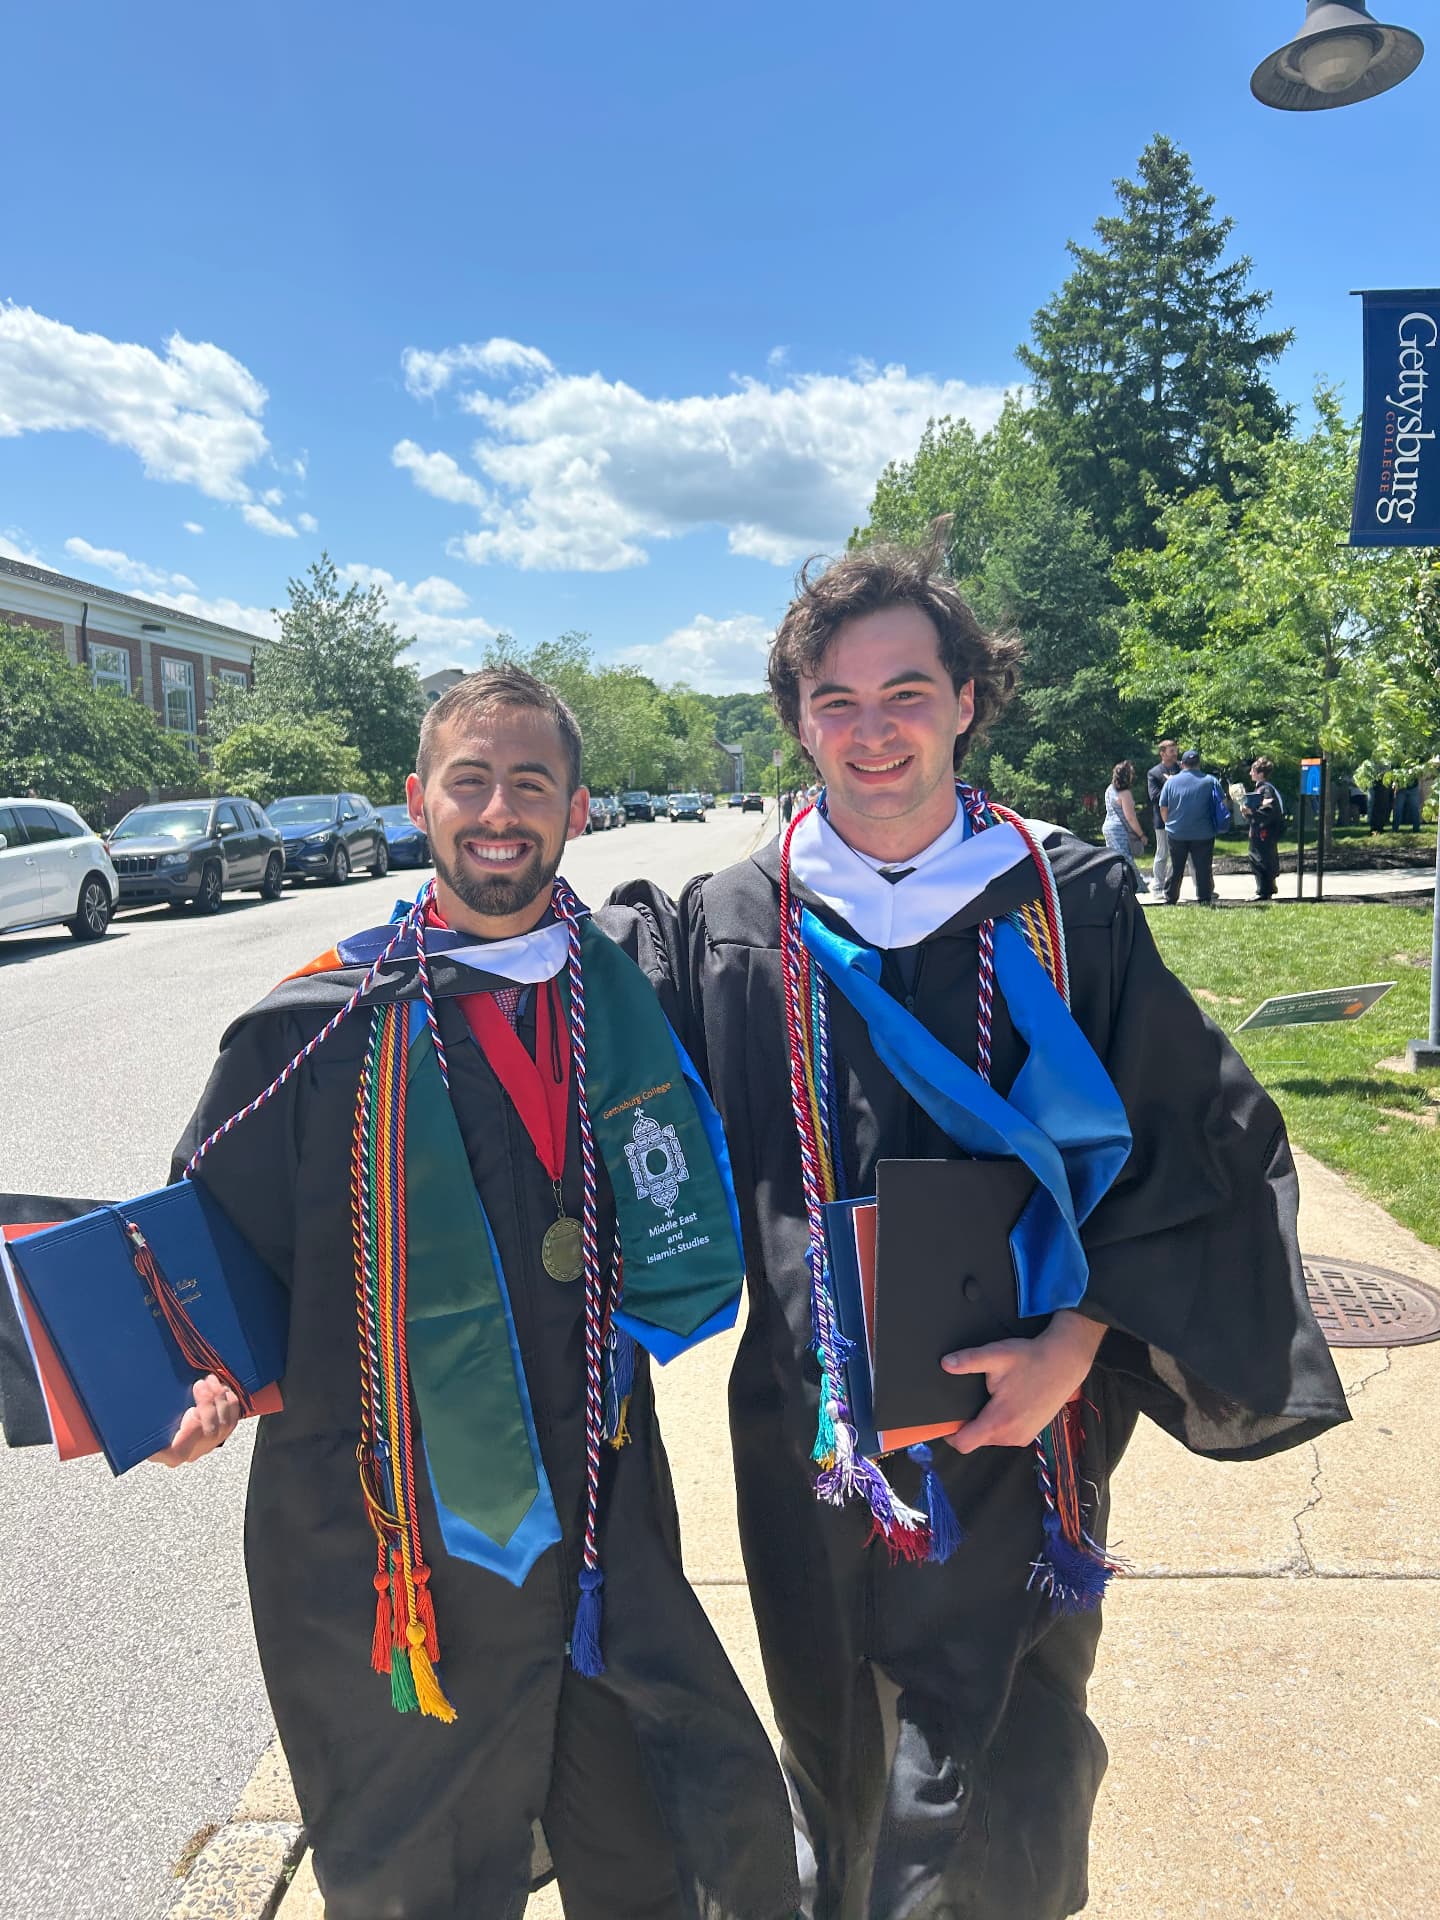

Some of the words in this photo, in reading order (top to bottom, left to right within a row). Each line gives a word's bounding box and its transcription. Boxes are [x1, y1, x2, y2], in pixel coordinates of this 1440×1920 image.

[1376, 311, 1438, 524] Gettysburg
[1380, 411, 1395, 493] COLLEGE
[603, 1096, 642, 1119] Gettysburg
[642, 1082, 671, 1100] College
[649, 1220, 678, 1238] Middle
[679, 1212, 698, 1226] East
[667, 1229, 684, 1244] and
[647, 1247, 677, 1264] Islamic
[677, 1235, 710, 1253] Studies
